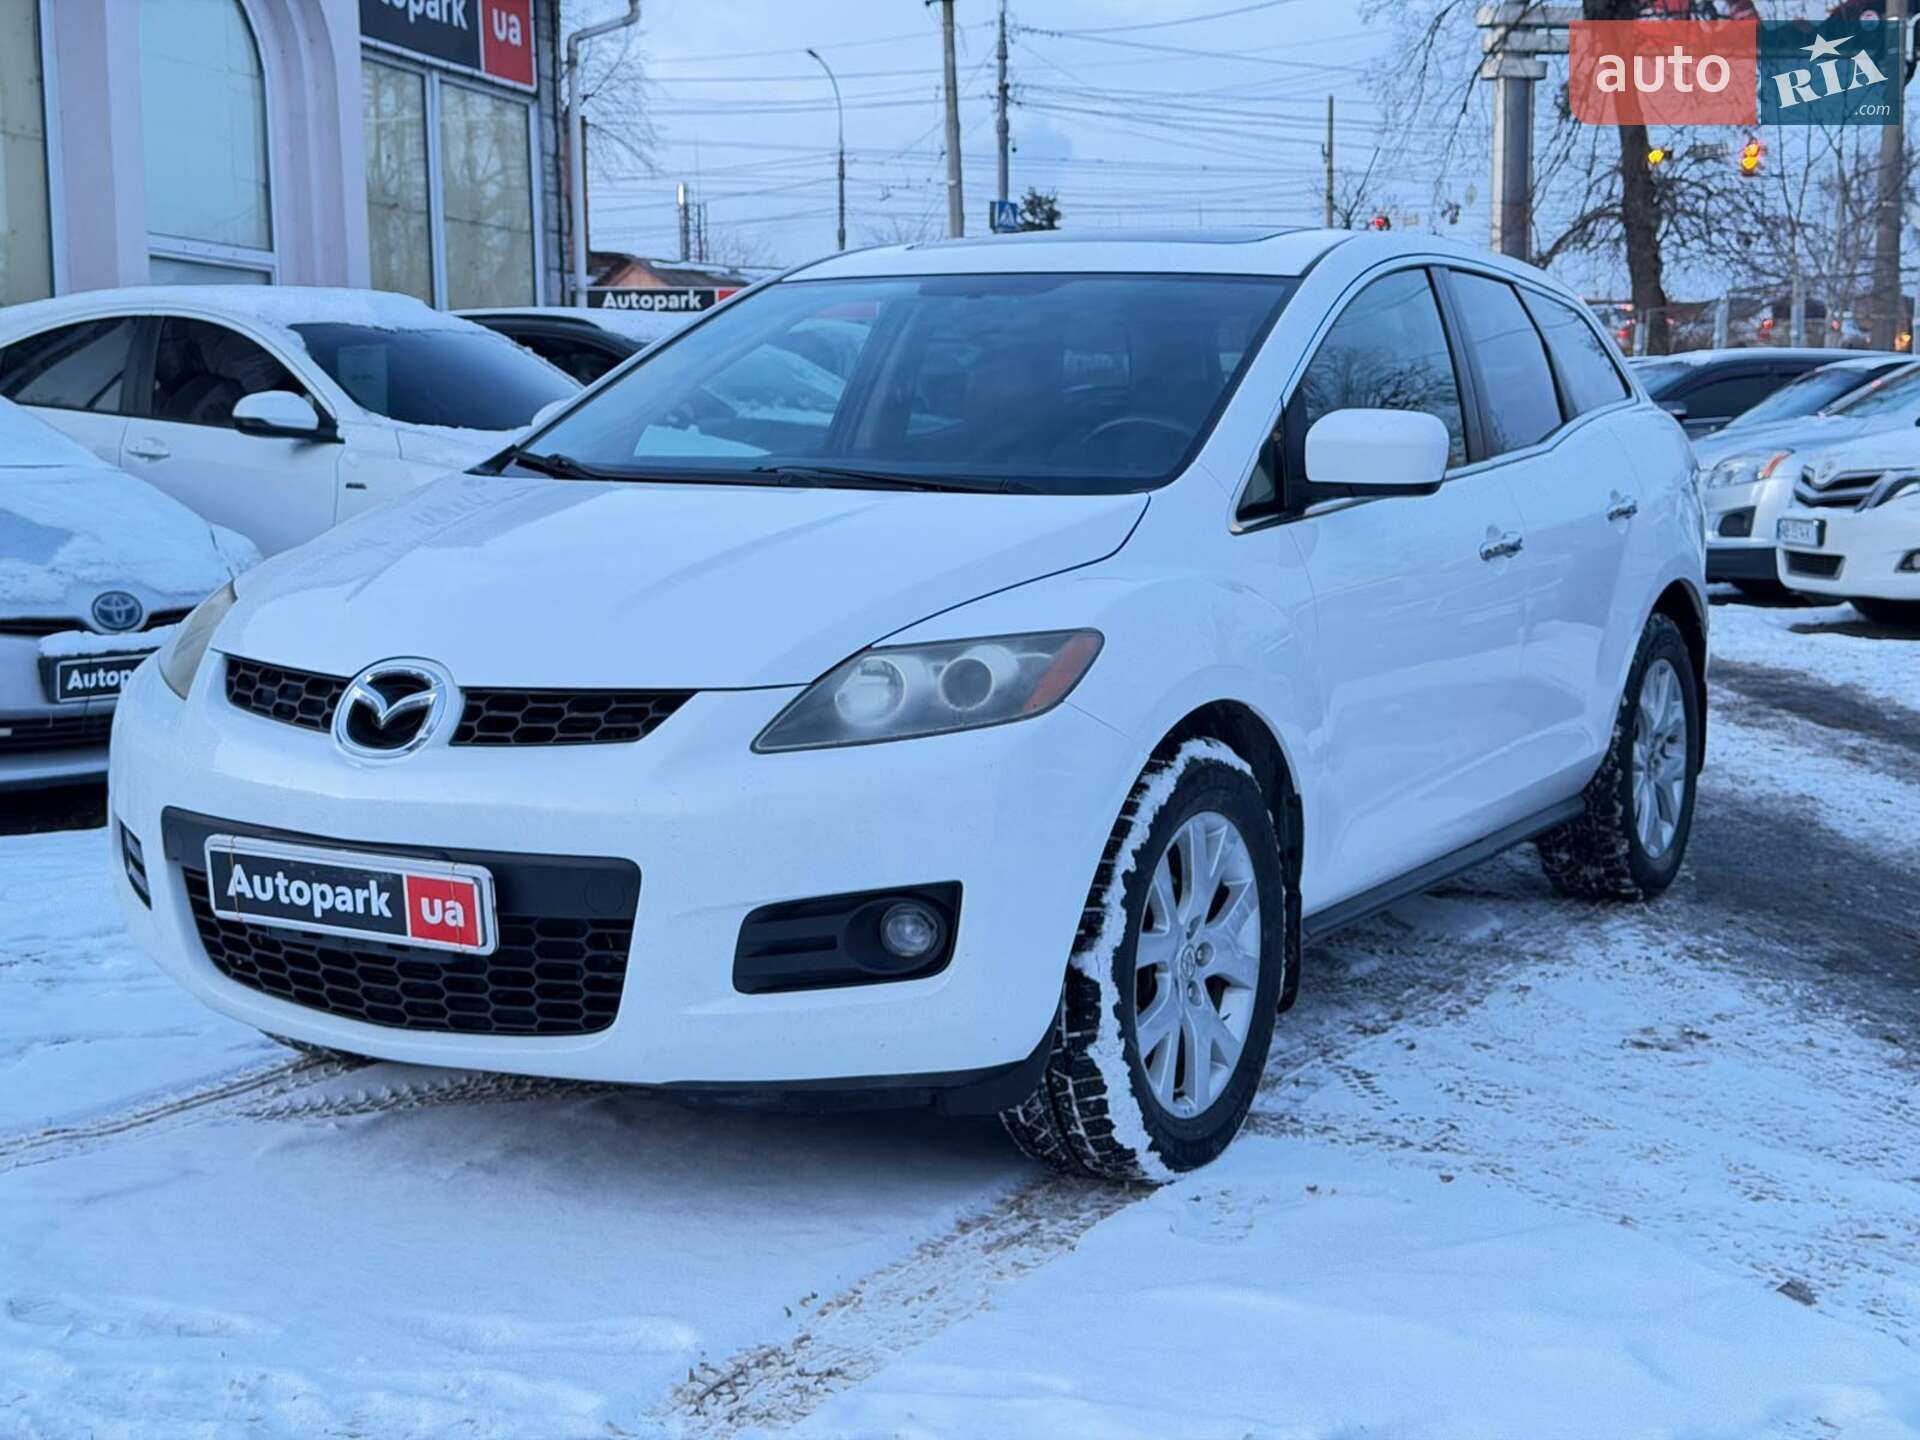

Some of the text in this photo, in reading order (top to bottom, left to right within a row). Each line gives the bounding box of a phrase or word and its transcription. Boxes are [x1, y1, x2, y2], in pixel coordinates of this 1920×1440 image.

[492, 7, 522, 48] ua
[602, 289, 702, 312] Autopark
[227, 863, 466, 928] Autopark ua
